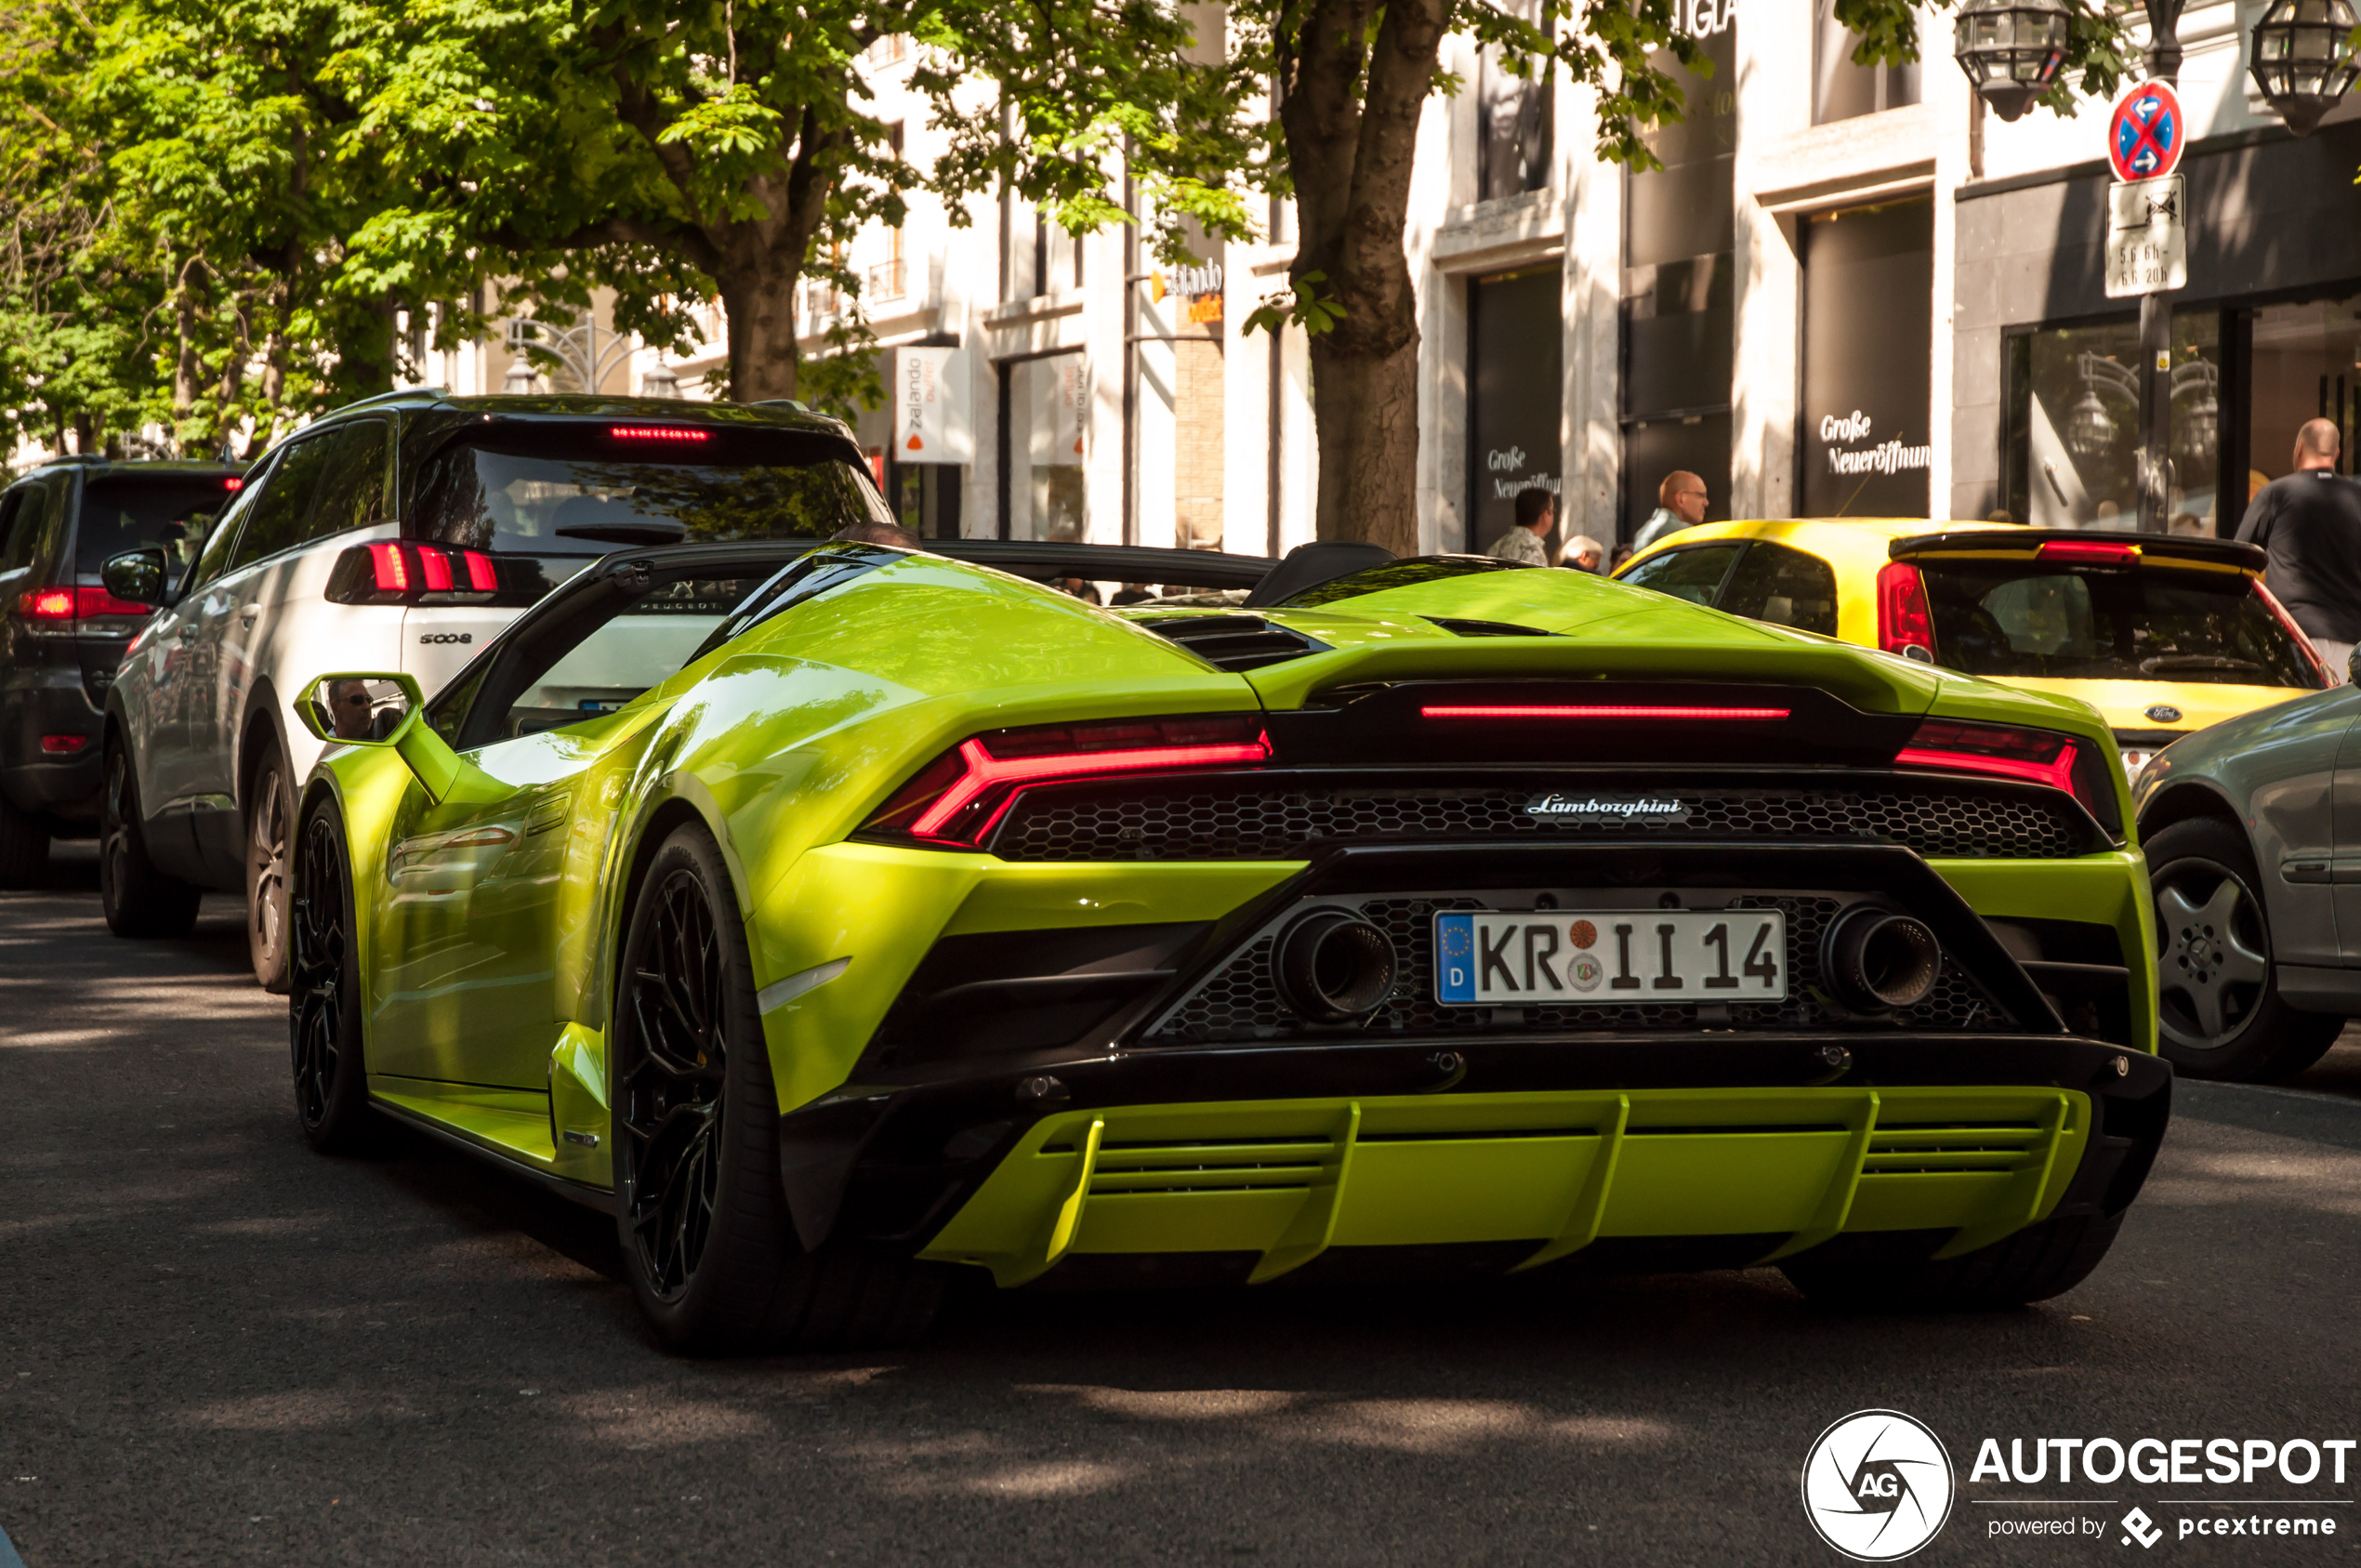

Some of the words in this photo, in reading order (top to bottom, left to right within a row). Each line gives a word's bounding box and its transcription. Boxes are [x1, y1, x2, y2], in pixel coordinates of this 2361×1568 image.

[1167, 257, 1222, 295] zalando
[907, 358, 922, 428] zalando
[1820, 409, 1871, 443] Große
[1488, 445, 1525, 472] Große
[419, 633, 472, 644] 5008
[1527, 794, 1682, 817] Lamborghini
[1480, 924, 1563, 992] KR
[1450, 968, 1464, 987] D
